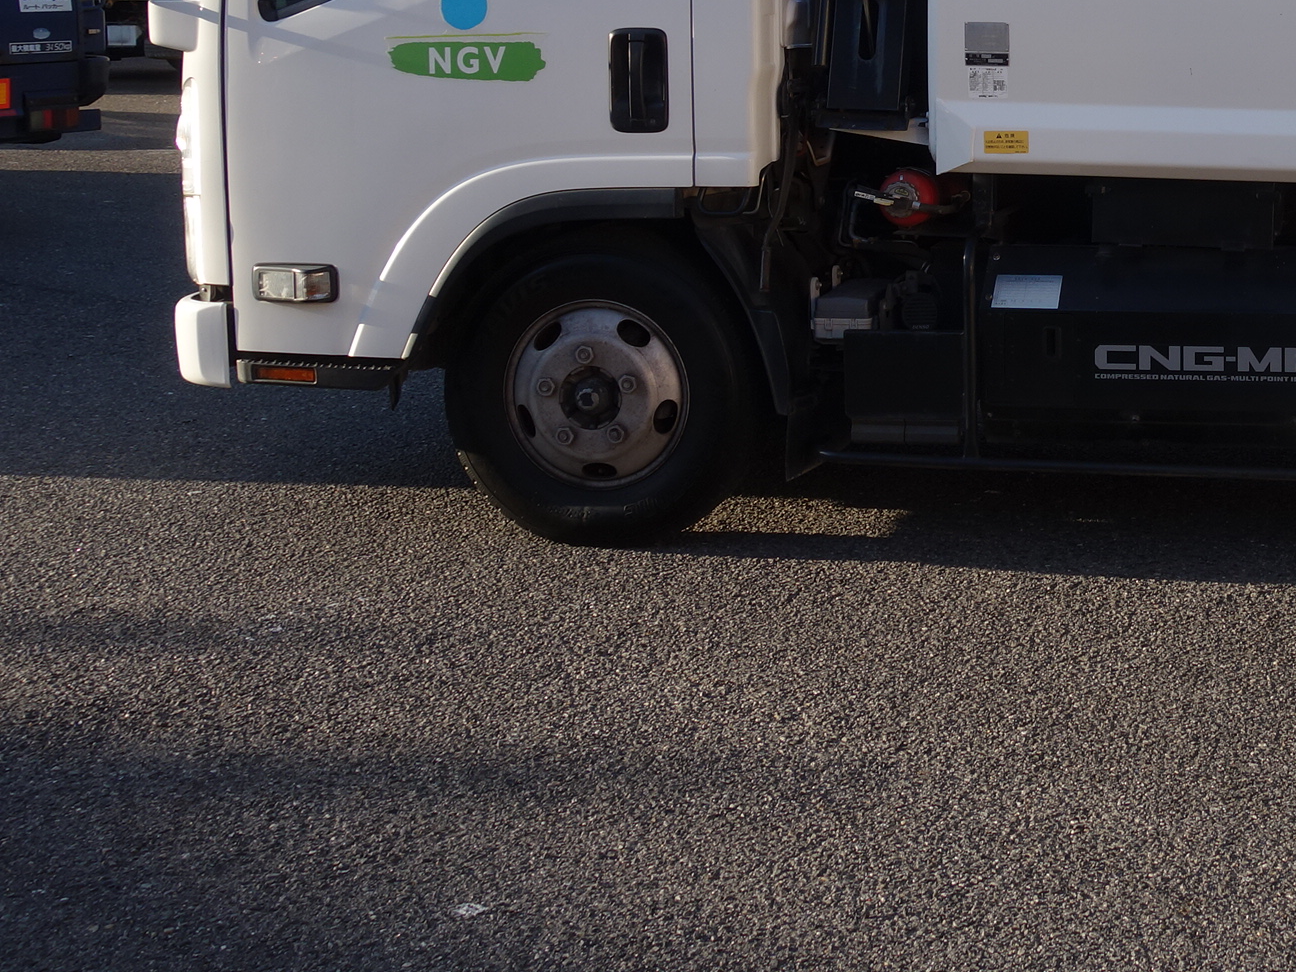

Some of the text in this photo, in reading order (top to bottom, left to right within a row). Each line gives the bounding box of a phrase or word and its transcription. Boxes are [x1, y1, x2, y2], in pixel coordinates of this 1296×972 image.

[427, 46, 506, 74] NGV
[1094, 372, 1159, 380] COMPRESSED
[1206, 374, 1259, 382] GAS-MULTI
[1260, 375, 1290, 383] POINT
